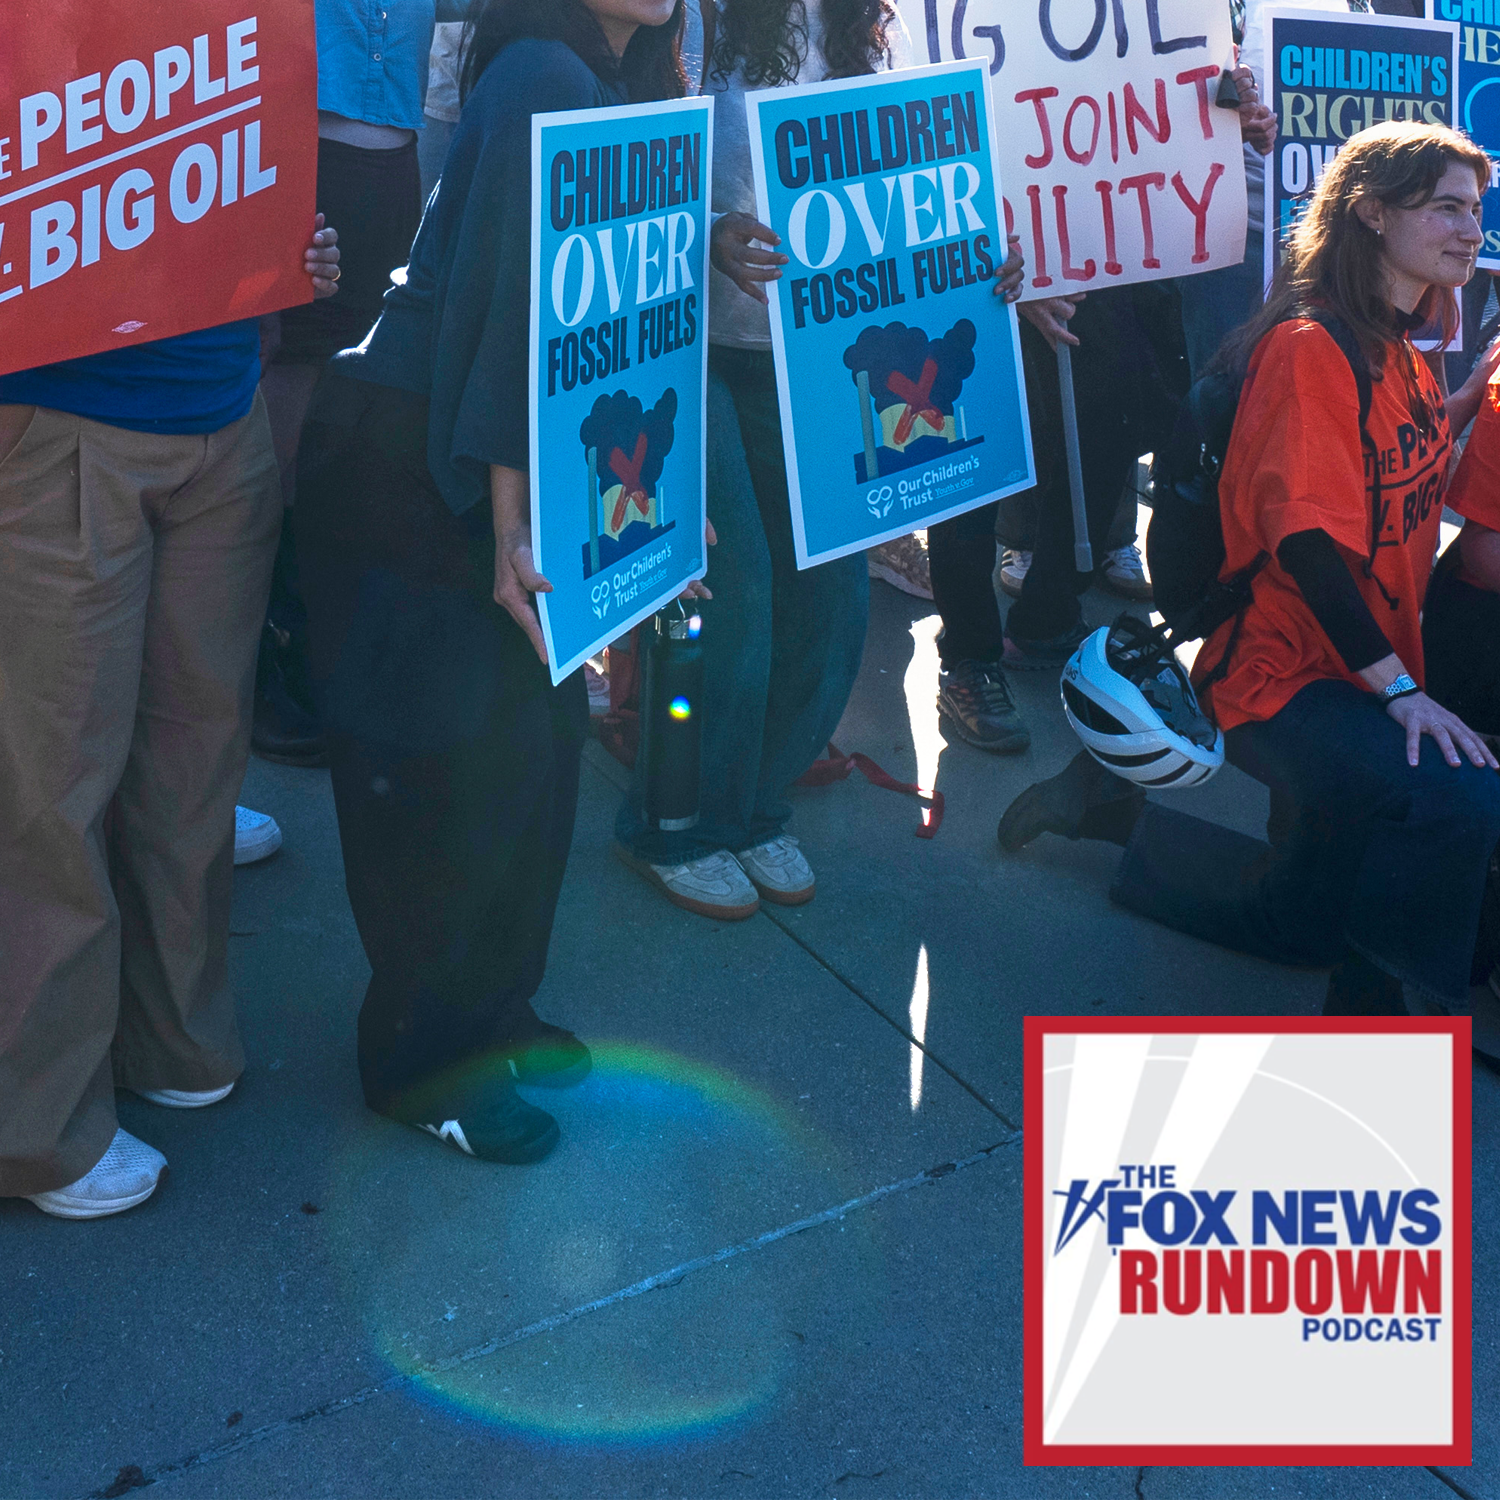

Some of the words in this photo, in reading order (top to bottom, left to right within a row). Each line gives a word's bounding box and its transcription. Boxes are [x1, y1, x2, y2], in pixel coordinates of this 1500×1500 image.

[19, 16, 260, 171] PEOPLE
[1014, 64, 1220, 169] JOINT
[1280, 44, 1448, 96] CHILDREN'S
[550, 132, 701, 233] CHILDREN
[774, 91, 981, 189] CHILDREN
[29, 168, 155, 290] BIG
[169, 119, 277, 224] OIL
[787, 161, 987, 270] OVER
[551, 211, 696, 327] OVER
[790, 253, 906, 330] FOSSIL
[912, 233, 994, 300] FUELS
[547, 319, 630, 399] FOSSIL
[637, 294, 697, 366] FUELS
[897, 477, 922, 495] Our
[900, 488, 933, 510] Trust
[613, 569, 631, 590] Our
[614, 581, 639, 608] Trust
